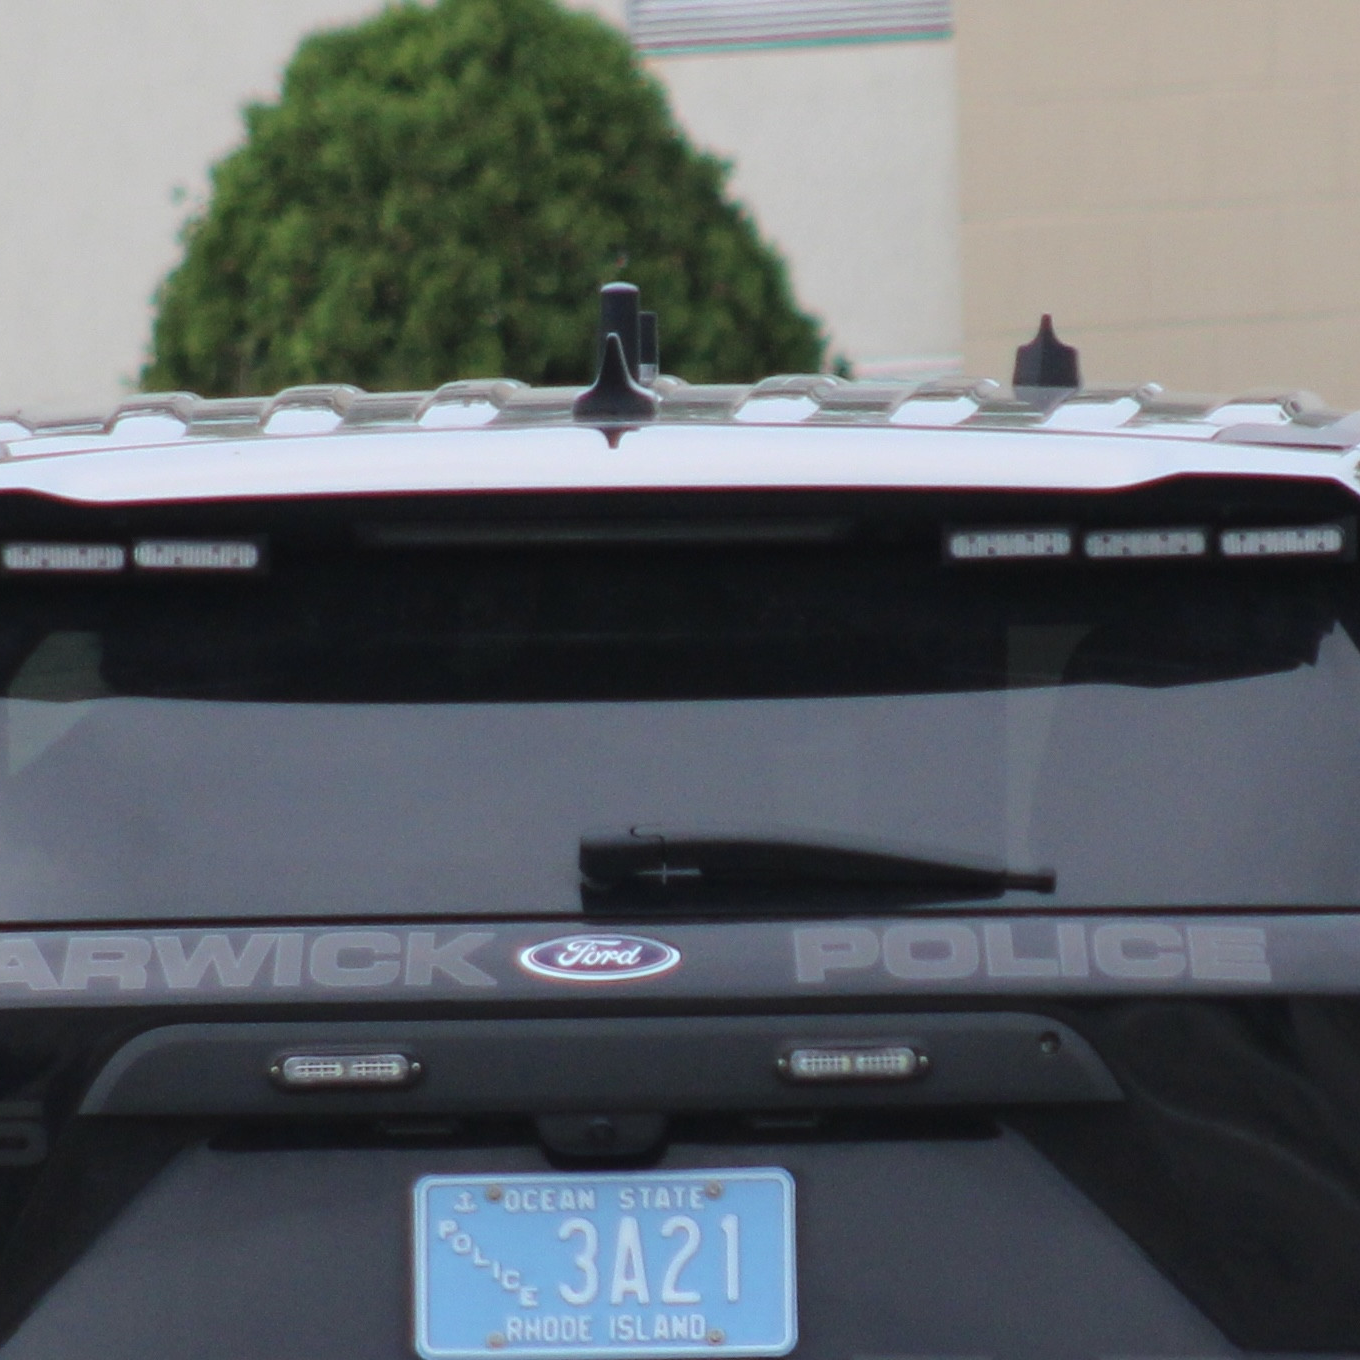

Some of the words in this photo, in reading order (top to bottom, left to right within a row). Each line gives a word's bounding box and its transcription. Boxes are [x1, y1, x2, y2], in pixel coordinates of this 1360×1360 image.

[556, 938, 644, 968] Ford
[793, 923, 1271, 984] POLICE
[504, 1189, 596, 1211] OCEAN
[620, 1186, 705, 1210] STATE
[438, 1220, 538, 1307] POLICE
[558, 1213, 739, 1305] 3A21
[506, 1314, 593, 1342] RHODE
[609, 1312, 706, 1341] ISLAND
